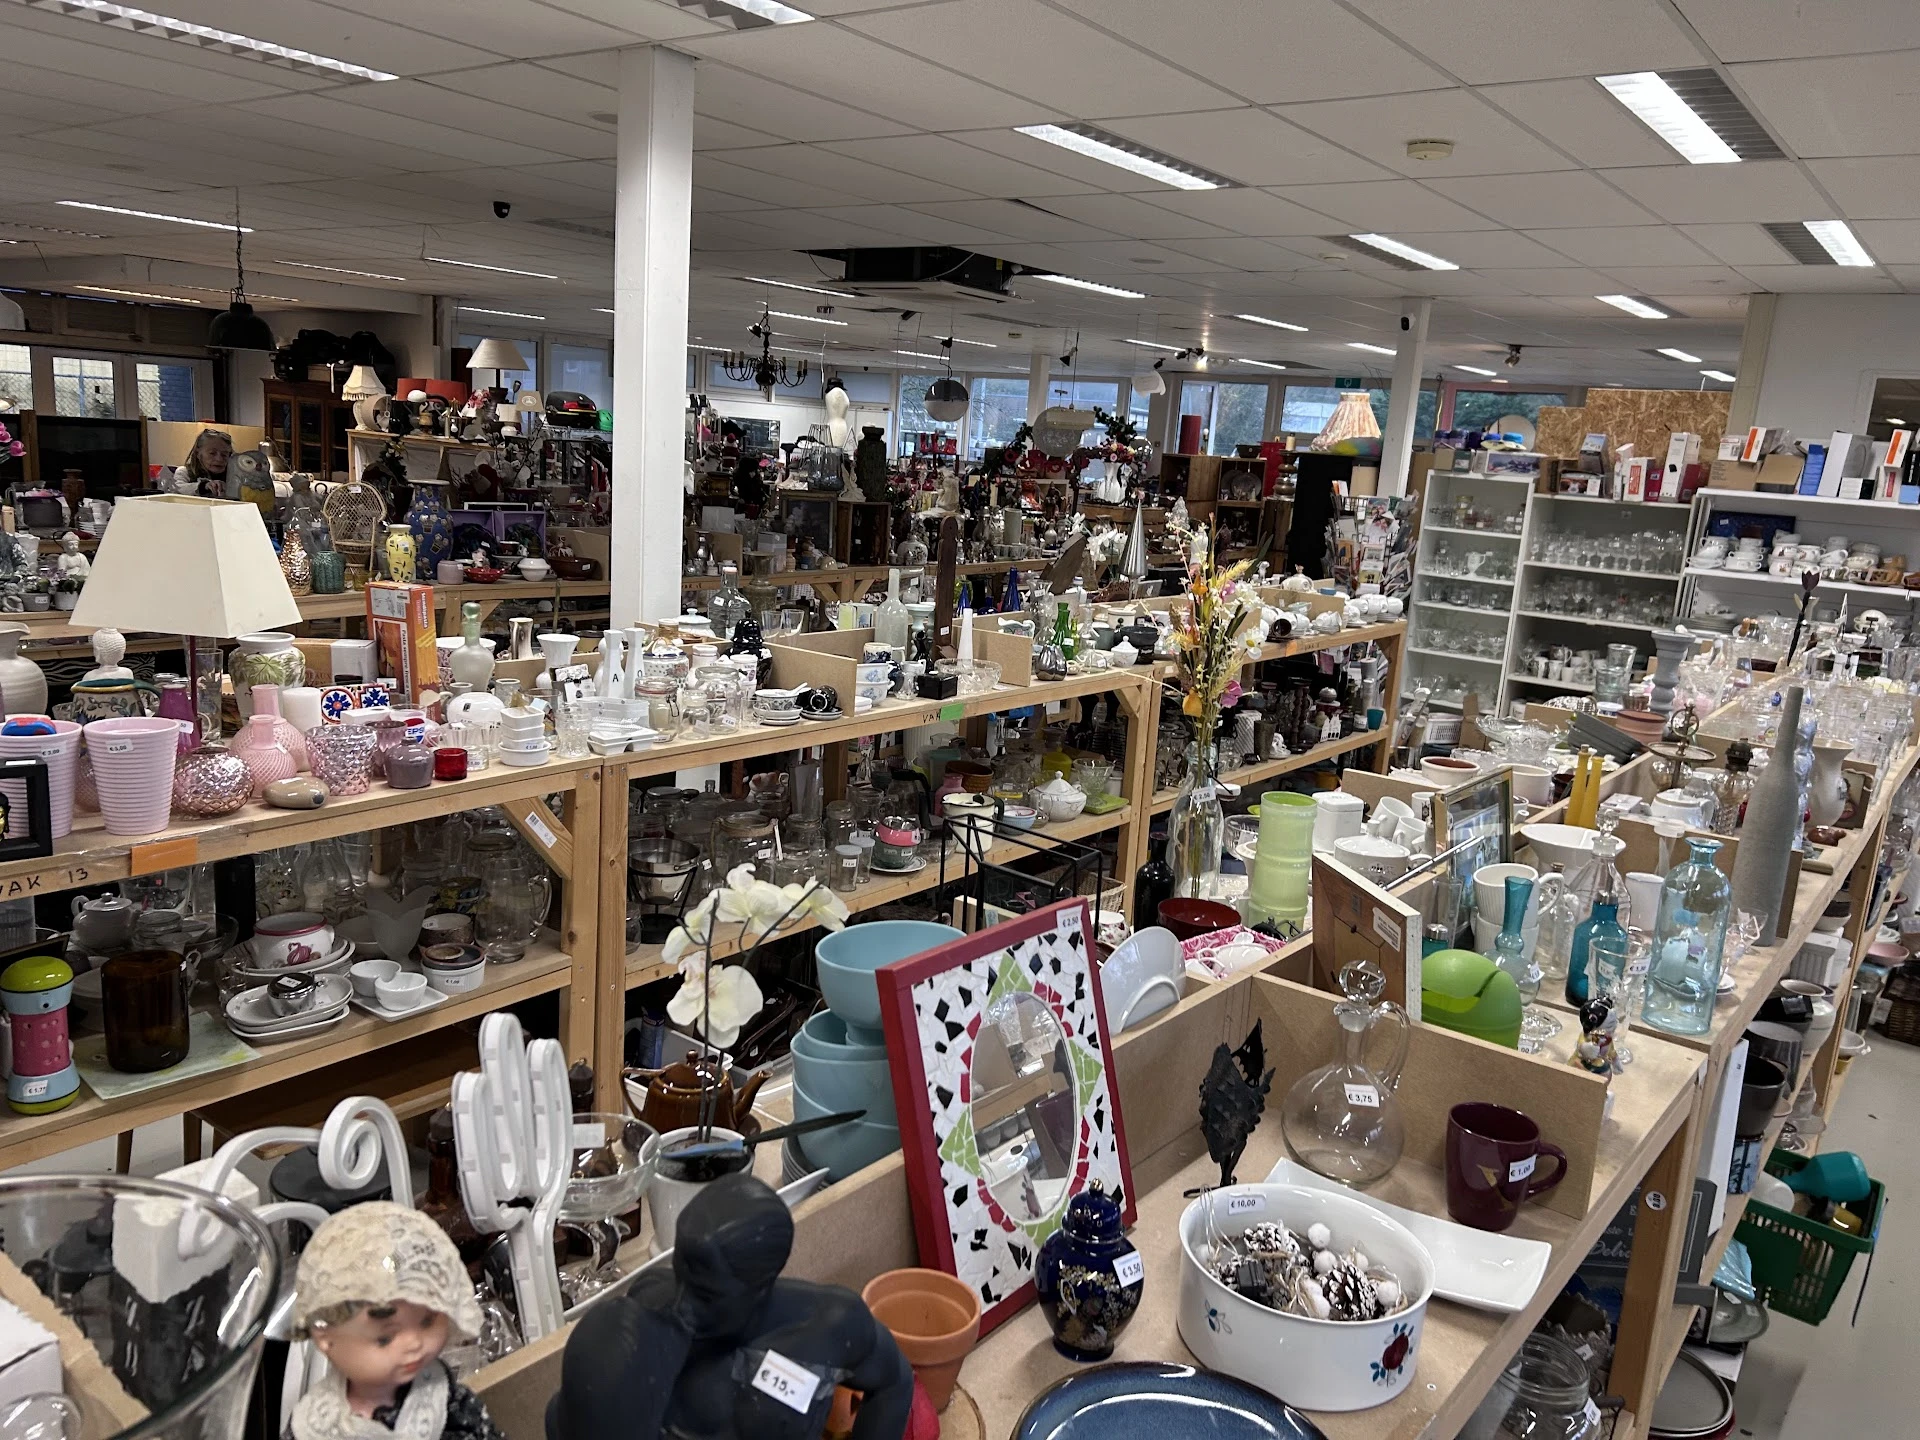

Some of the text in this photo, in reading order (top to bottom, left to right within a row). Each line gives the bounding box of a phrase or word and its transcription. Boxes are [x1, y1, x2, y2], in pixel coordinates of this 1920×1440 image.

[612, 673, 619, 682] A
[68, 867, 88, 884] 13
[1348, 1093, 1372, 1103] € 3,75
[1230, 1199, 1256, 1208] € 10,00
[1122, 1262, 1141, 1277] € 3,50
[761, 1369, 795, 1396] € 15,-
